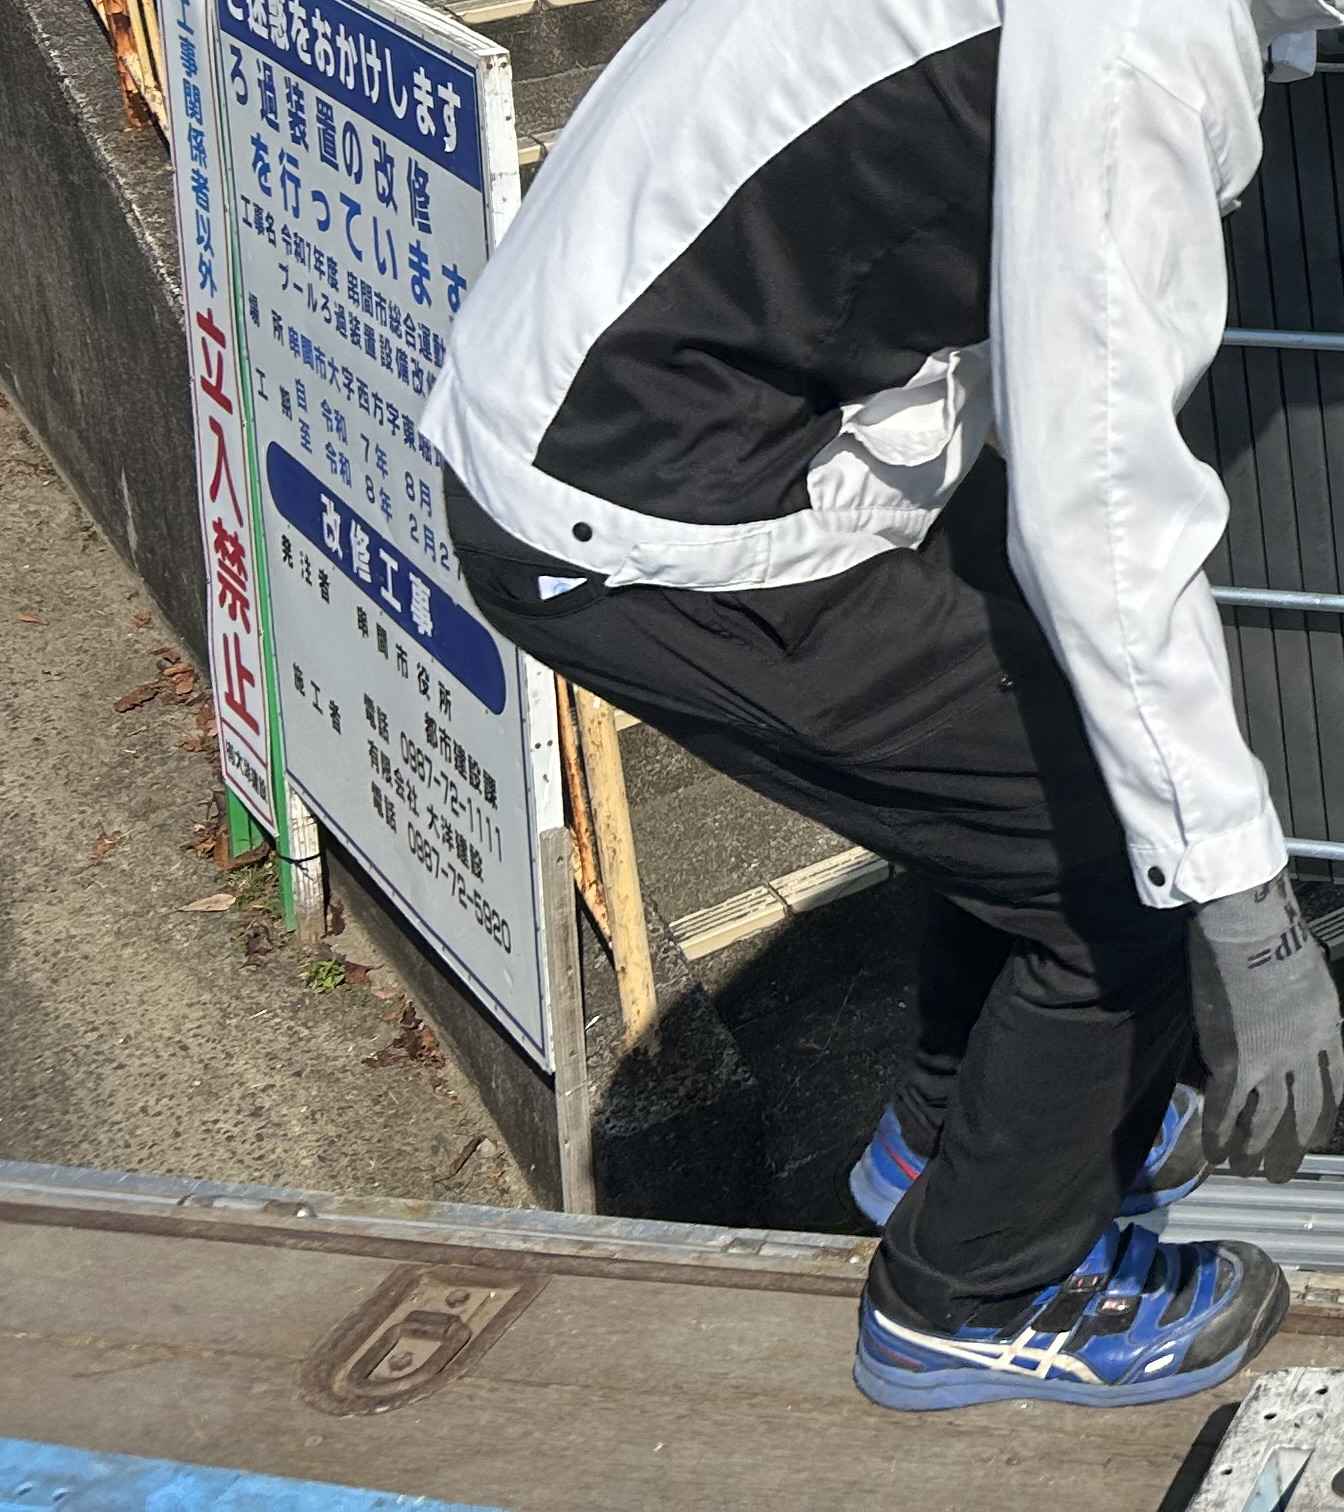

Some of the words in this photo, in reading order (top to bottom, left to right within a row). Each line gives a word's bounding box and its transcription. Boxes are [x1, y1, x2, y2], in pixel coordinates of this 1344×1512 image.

[229, 43, 432, 235] ろ過装置の改修
[250, 131, 467, 320] を行っています
[197, 307, 260, 736] 立入禁止
[320, 492, 434, 638] 改修工事
[400, 730, 502, 863] 0987-72-1111
